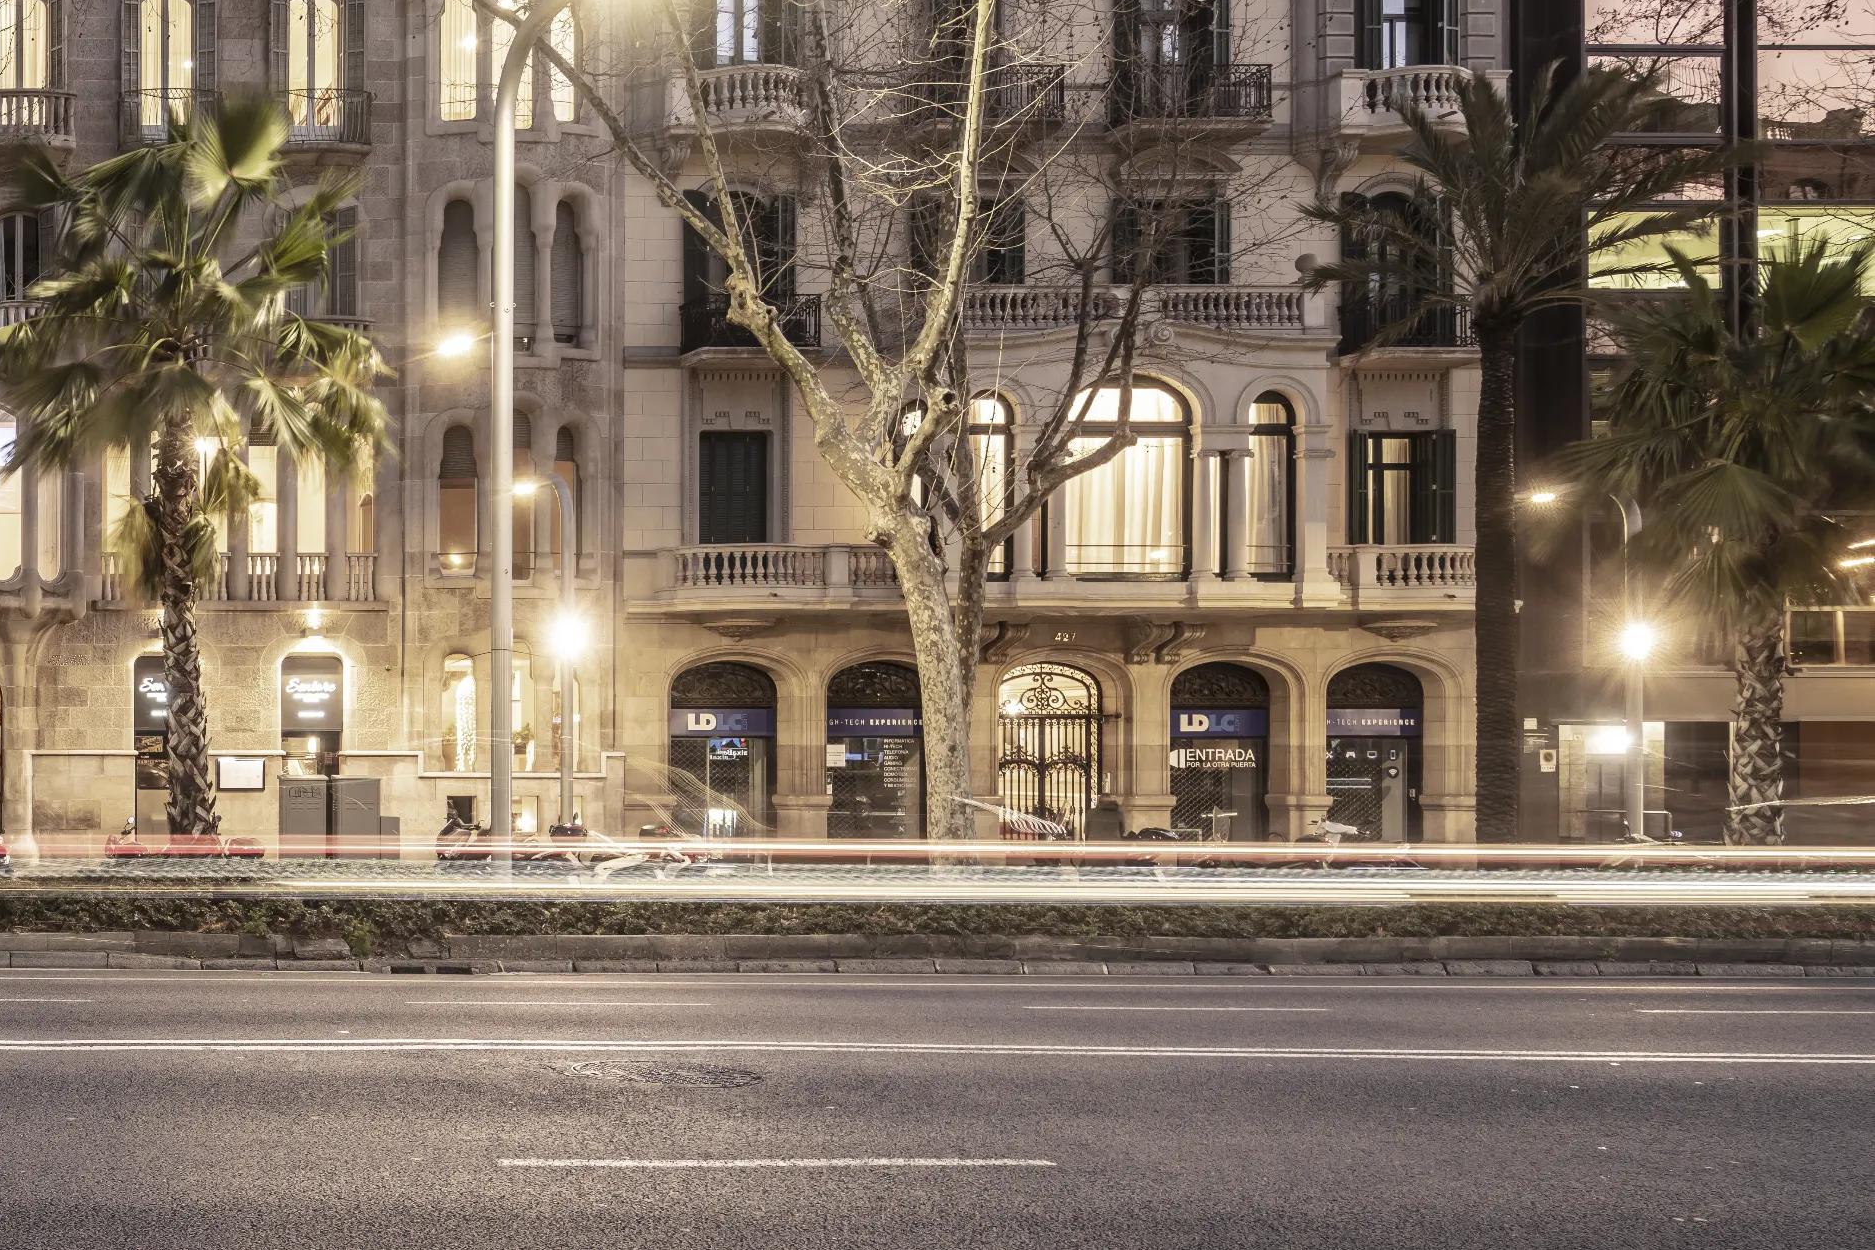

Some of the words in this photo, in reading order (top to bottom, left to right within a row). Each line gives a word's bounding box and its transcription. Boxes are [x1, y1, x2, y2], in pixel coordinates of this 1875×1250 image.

[1054, 632, 1076, 642] 427
[687, 713, 742, 731] LDLC
[828, 718, 865, 726] GH-TECH
[869, 718, 923, 726] EXPERIENCE
[1180, 713, 1235, 732] LDLC
[1361, 718, 1415, 726] EXPERIENCE
[1186, 748, 1256, 761] ENTRADA
